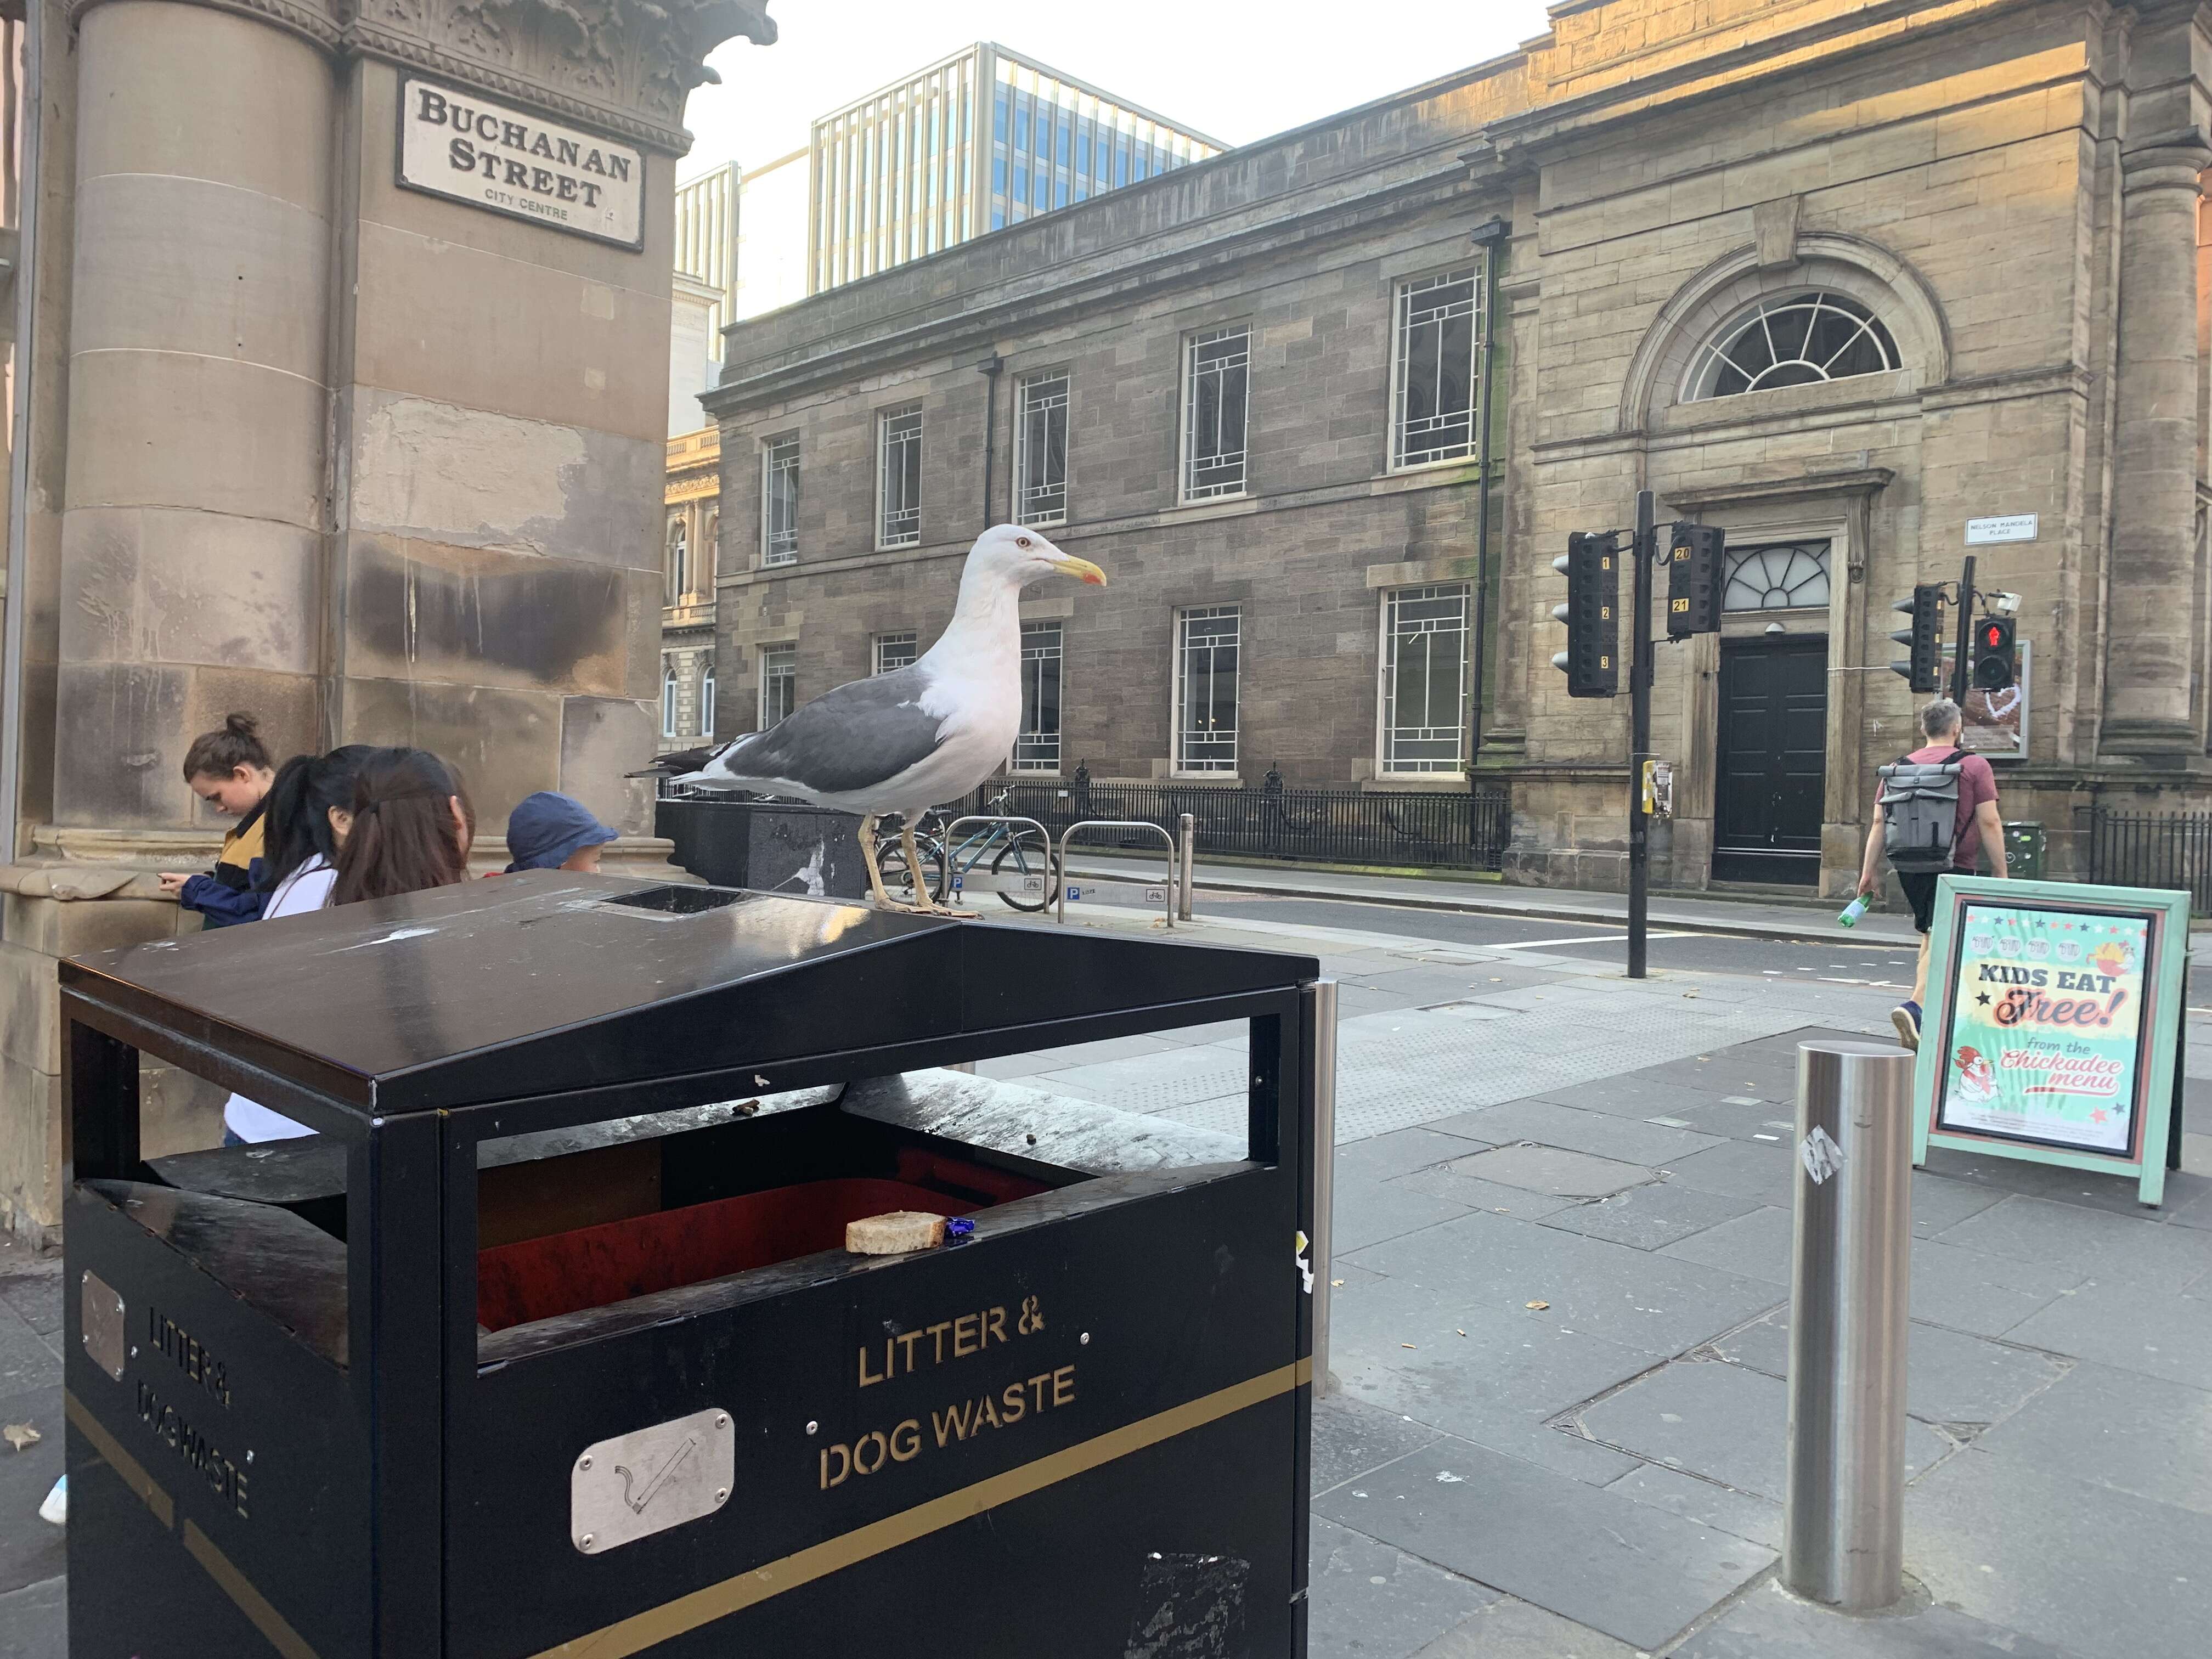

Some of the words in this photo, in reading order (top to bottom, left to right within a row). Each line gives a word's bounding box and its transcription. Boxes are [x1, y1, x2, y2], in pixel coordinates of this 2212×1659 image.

[417, 88, 631, 182] BUCHANAN
[448, 138, 602, 208] STREET
[485, 188, 514, 205] CITY
[520, 198, 568, 221] CENTRE
[1676, 548, 1689, 560] 20
[1603, 608, 1608, 618] 2
[1674, 600, 1686, 611] 21
[1602, 657, 1607, 667] 3
[953, 877, 962, 888] P
[1070, 888, 1079, 899] P
[1978, 963, 2048, 987] KIDS
[2057, 971, 2116, 994] EAT
[1996, 989, 2125, 1025] Free!
[2027, 1036, 2061, 1050] from
[2067, 1041, 2091, 1054] the
[2000, 1049, 2123, 1074] Chickadee
[2048, 1072, 2117, 1090] menu
[150, 1306, 213, 1394] LITTER
[859, 1305, 1010, 1388] LITTER
[1018, 1295, 1045, 1335] &
[820, 1418, 923, 1491] DOG
[932, 1364, 1076, 1448] WASTE
